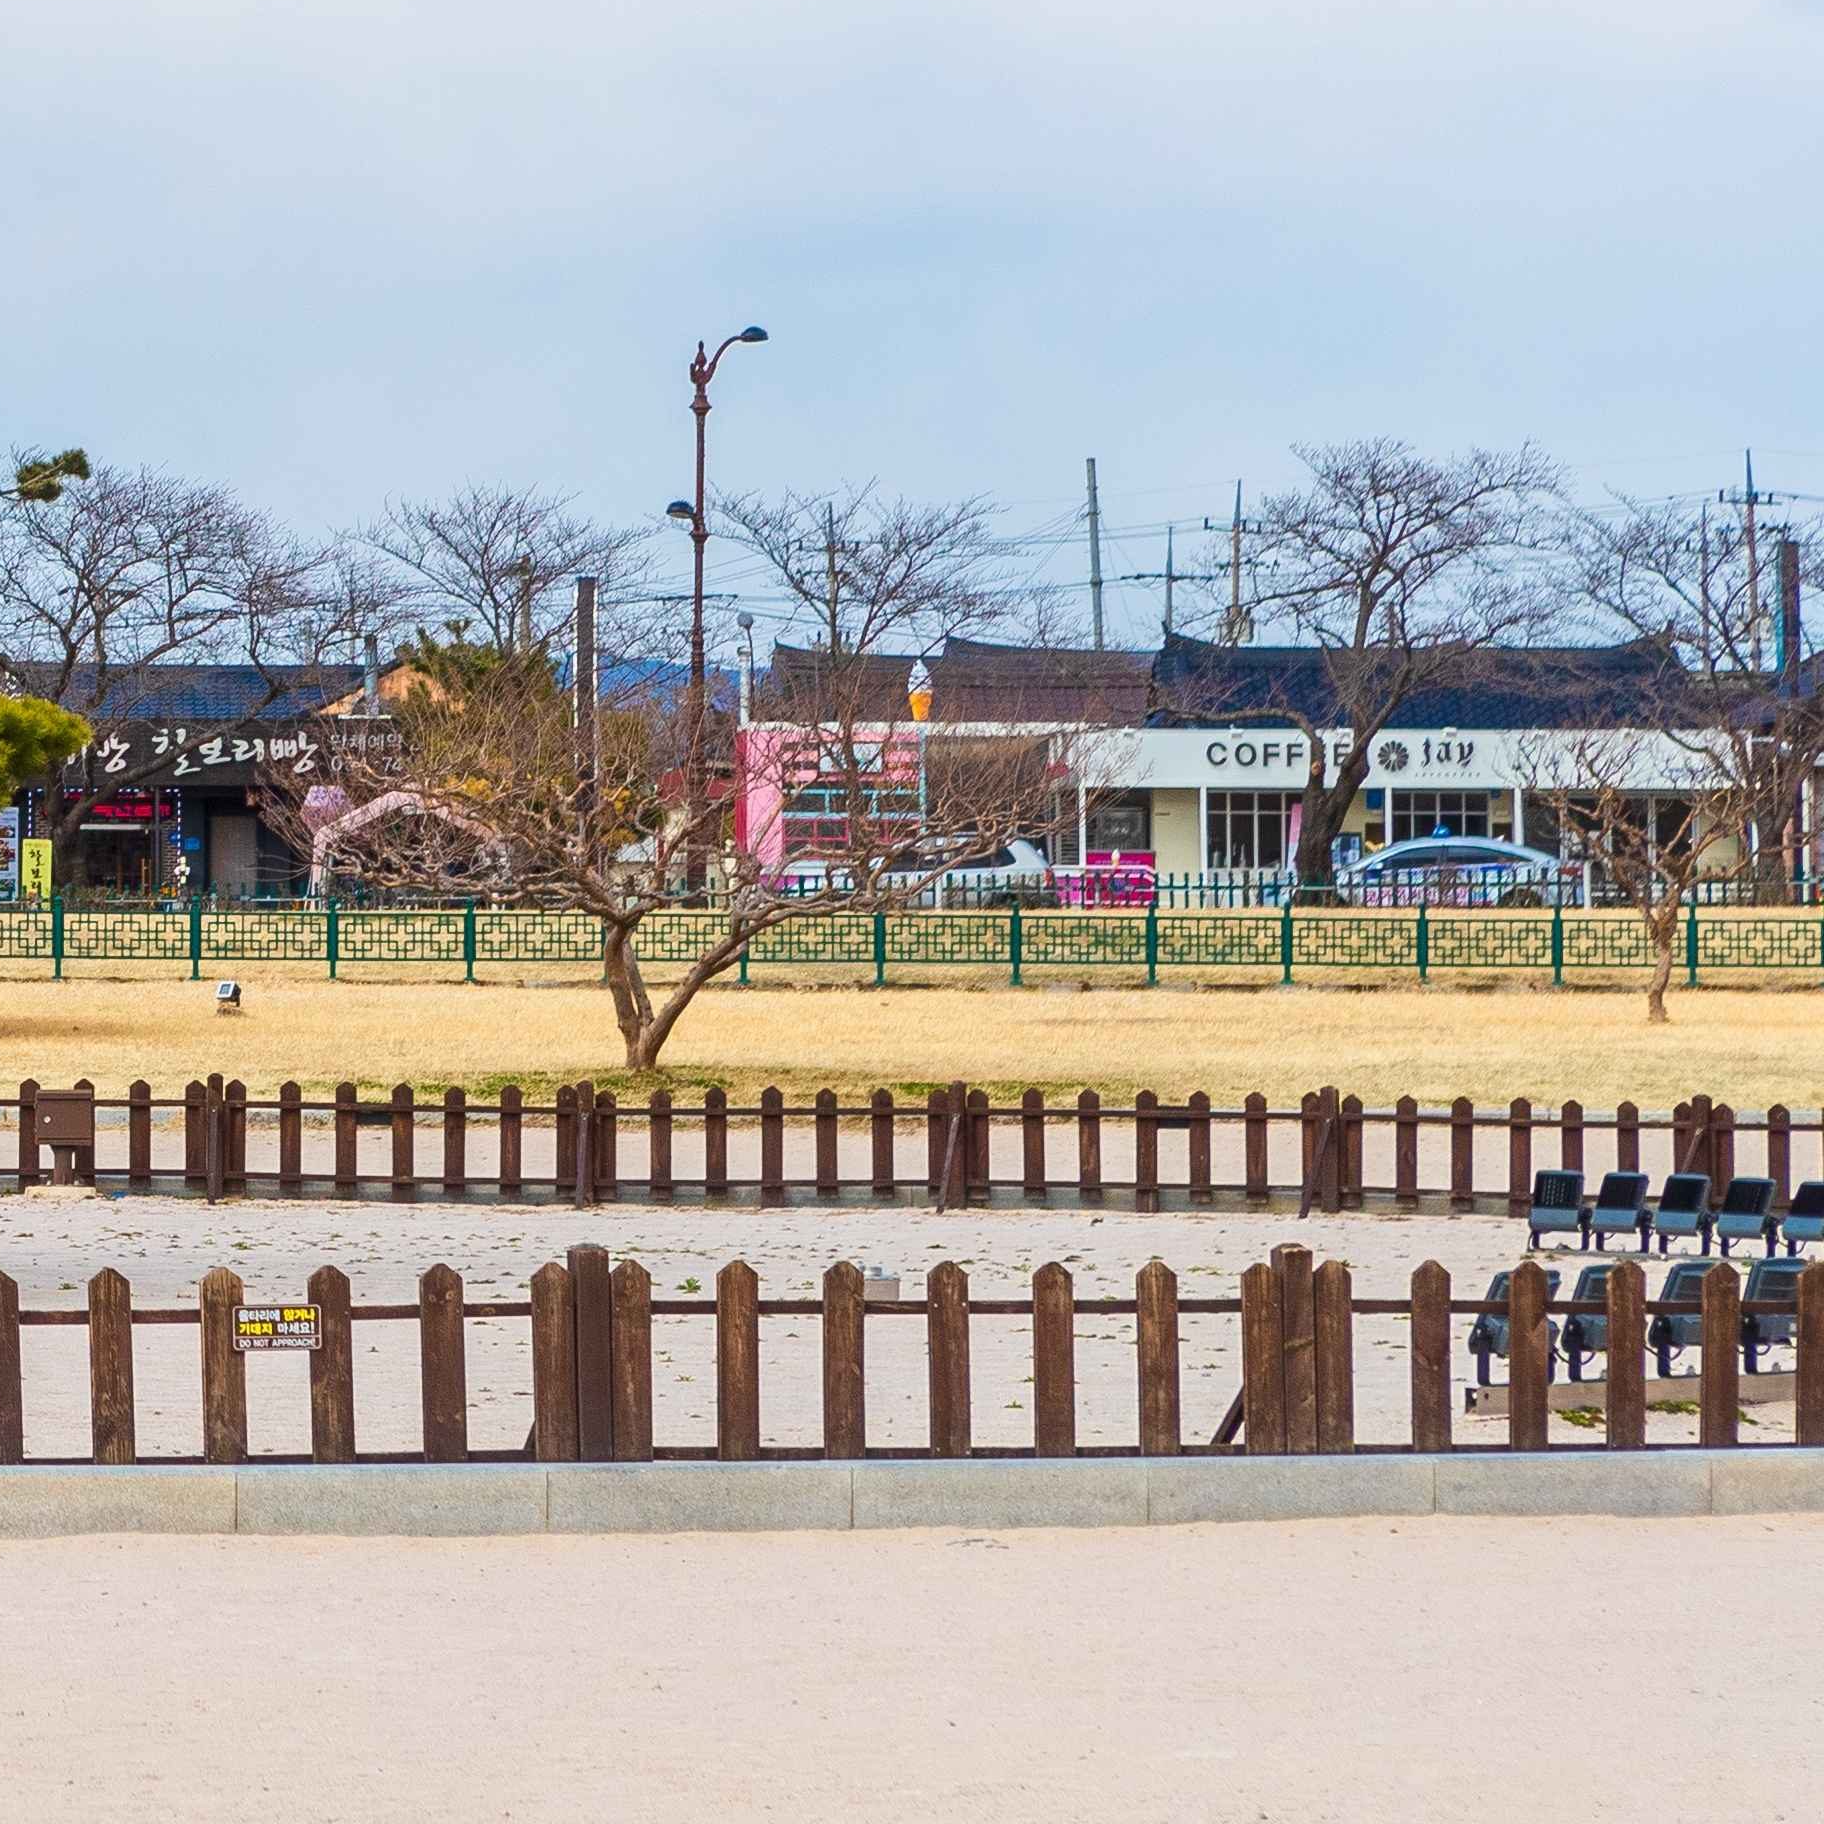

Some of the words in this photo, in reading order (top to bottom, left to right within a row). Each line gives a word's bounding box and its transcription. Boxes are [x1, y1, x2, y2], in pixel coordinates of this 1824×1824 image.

[1206, 742, 1353, 767] COFFE
[239, 1322, 273, 1336] 기대지
[277, 1321, 315, 1335] 마세요!
[239, 1339, 252, 1348] DO
[253, 1338, 270, 1348] NOT
[272, 1337, 316, 1348] APPROACH!
